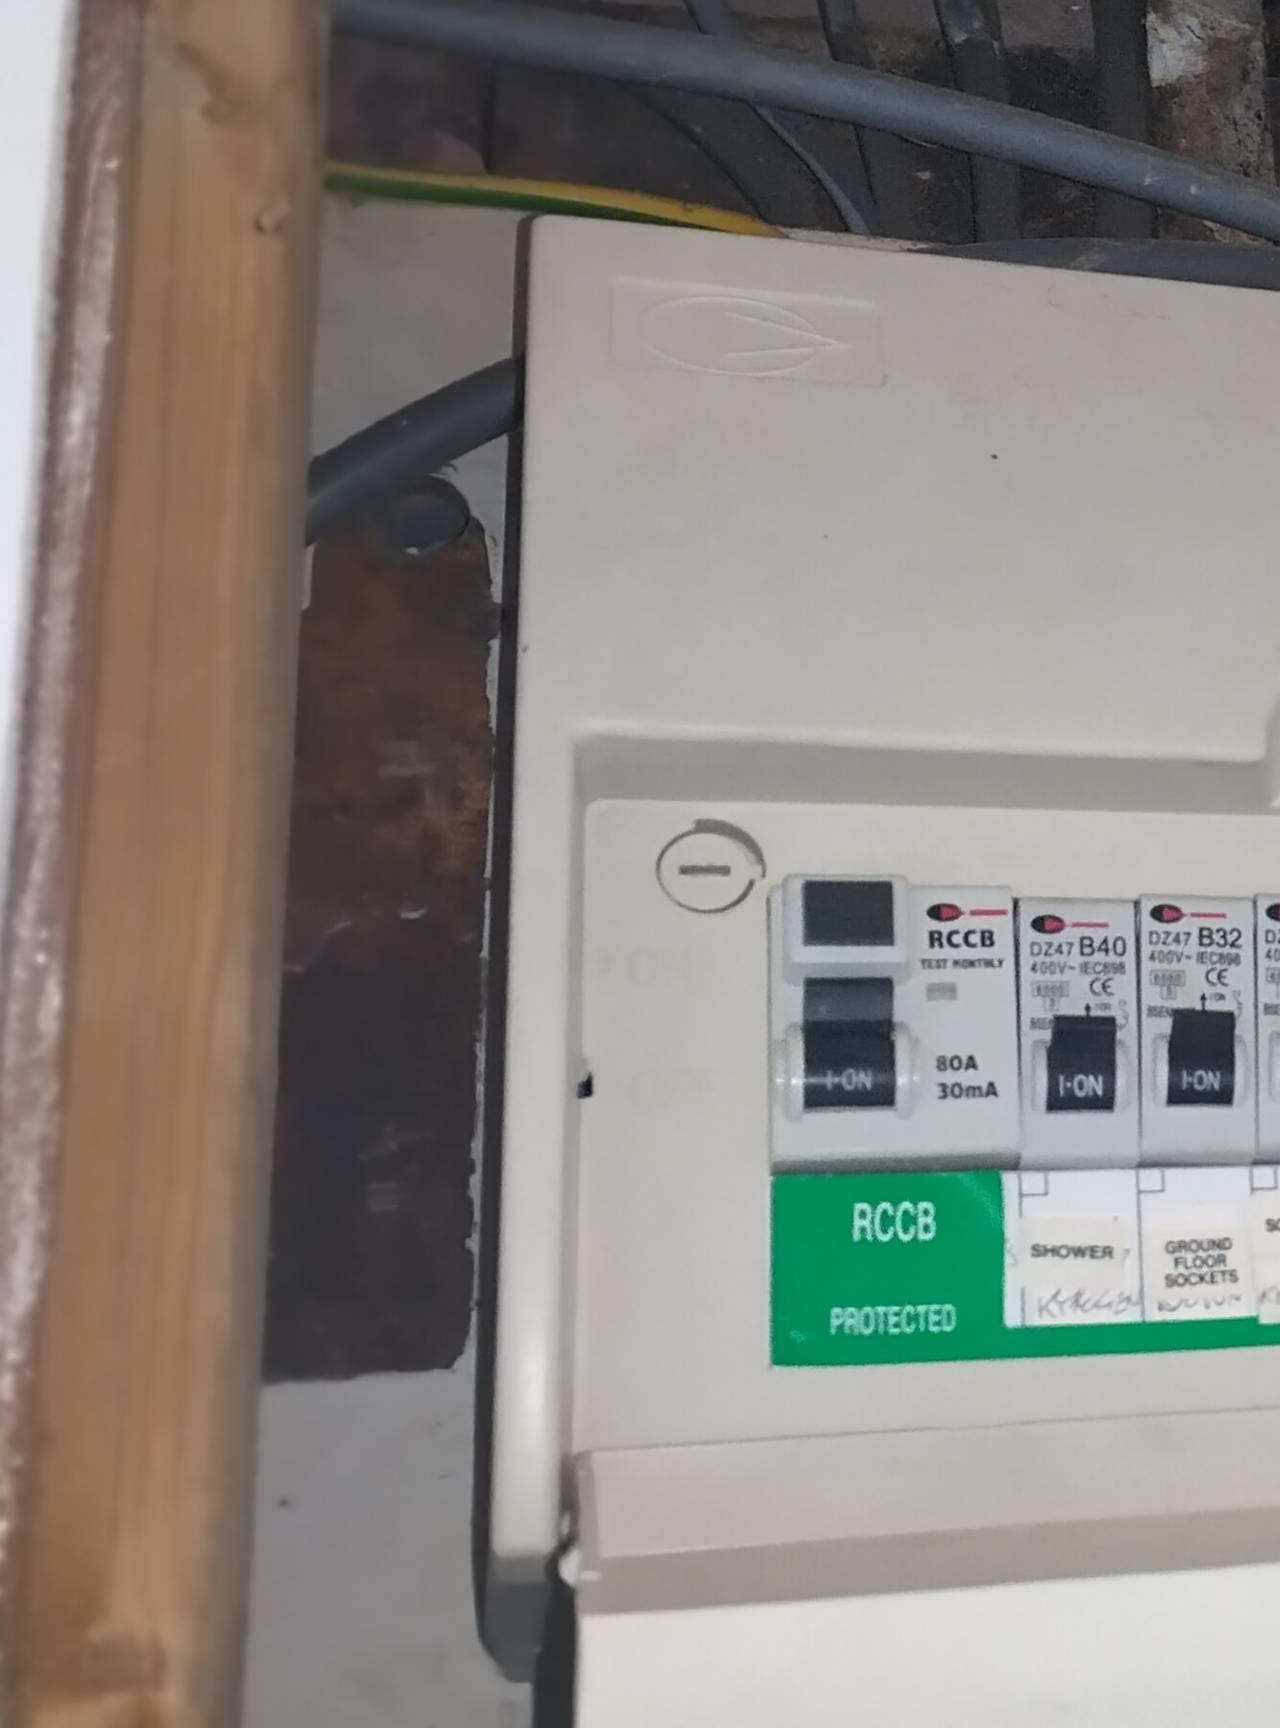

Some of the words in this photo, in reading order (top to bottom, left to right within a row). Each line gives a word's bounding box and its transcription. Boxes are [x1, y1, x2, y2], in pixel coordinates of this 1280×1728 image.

[928, 929, 995, 949] RCCB
[1030, 942, 1074, 957] DZ47
[1079, 936, 1127, 957] B40
[1148, 930, 1192, 946] DZ47
[1198, 927, 1242, 948] B32
[936, 1055, 979, 1072] 80A
[937, 1082, 999, 1100] 30mA
[852, 1201, 936, 1243] RCCB
[1030, 1243, 1114, 1260] SHOWER
[1164, 1237, 1233, 1254] GROUND
[1174, 1254, 1227, 1270] FLOOR
[1164, 1270, 1239, 1288] SOCKETS
[830, 1303, 957, 1335] PROTECTED
